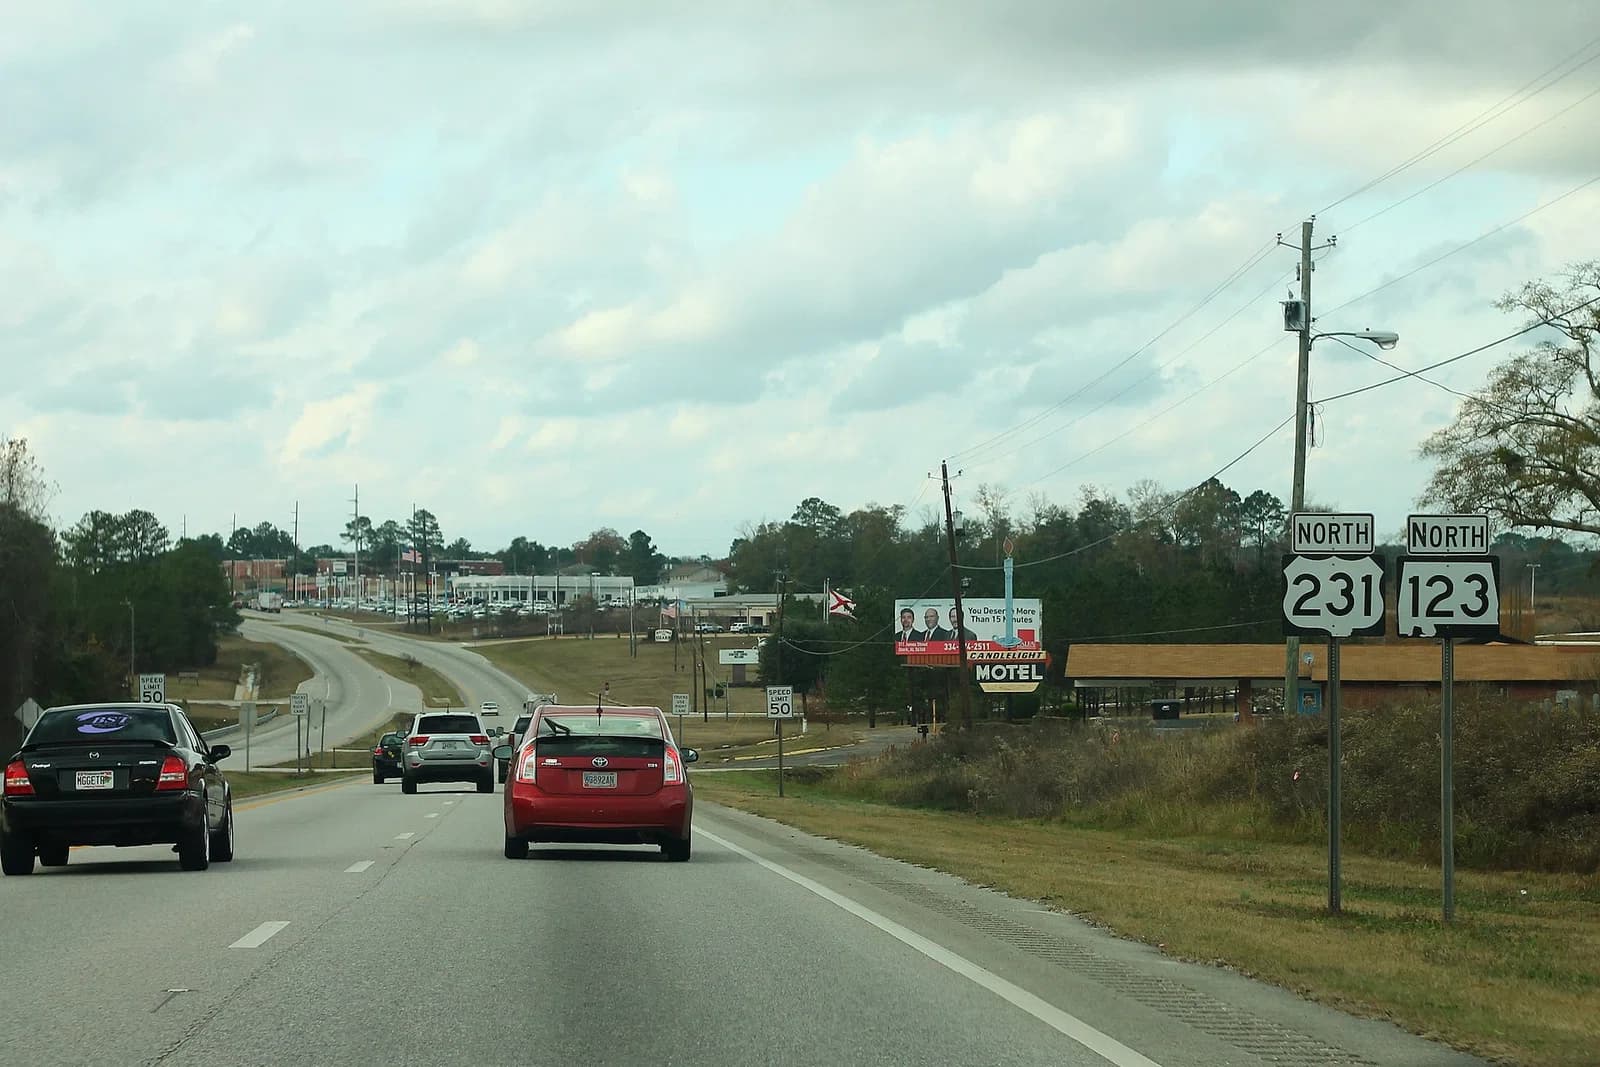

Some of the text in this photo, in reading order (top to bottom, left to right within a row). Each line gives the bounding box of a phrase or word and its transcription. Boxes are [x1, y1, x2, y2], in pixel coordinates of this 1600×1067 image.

[1298, 522, 1369, 545] NORTH
[1412, 522, 1484, 547] NORTH
[1292, 572, 1372, 616] 231
[1408, 573, 1489, 618] 123
[1016, 607, 1036, 615] More
[976, 664, 1043, 680] MOTEL
[143, 691, 163, 703] 50
[770, 702, 791, 715] 50
